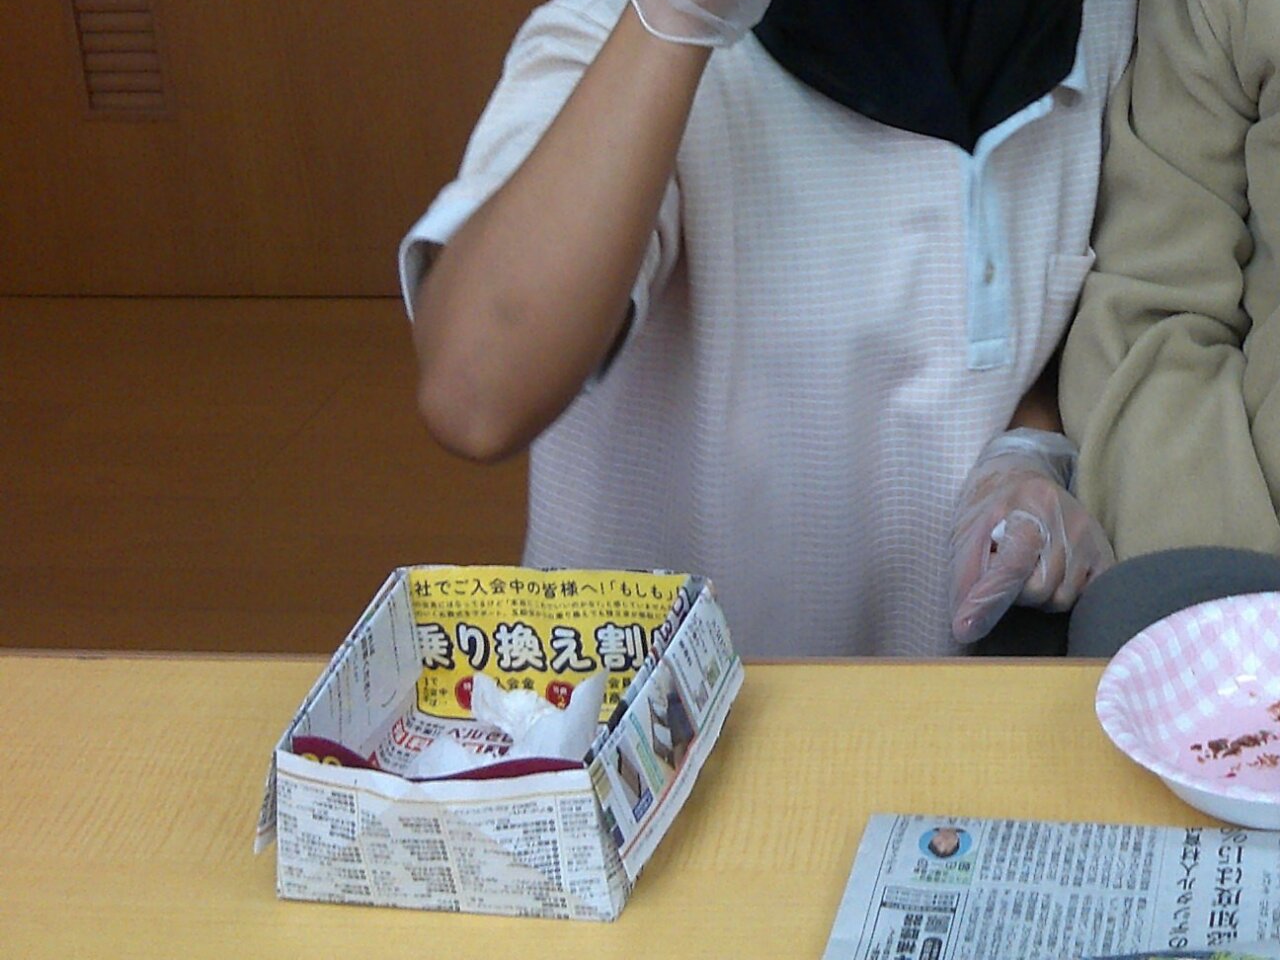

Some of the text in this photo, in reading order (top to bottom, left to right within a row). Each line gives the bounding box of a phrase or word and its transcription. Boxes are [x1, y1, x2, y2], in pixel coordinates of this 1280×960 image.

[416, 621, 660, 673] 乗り換え割
